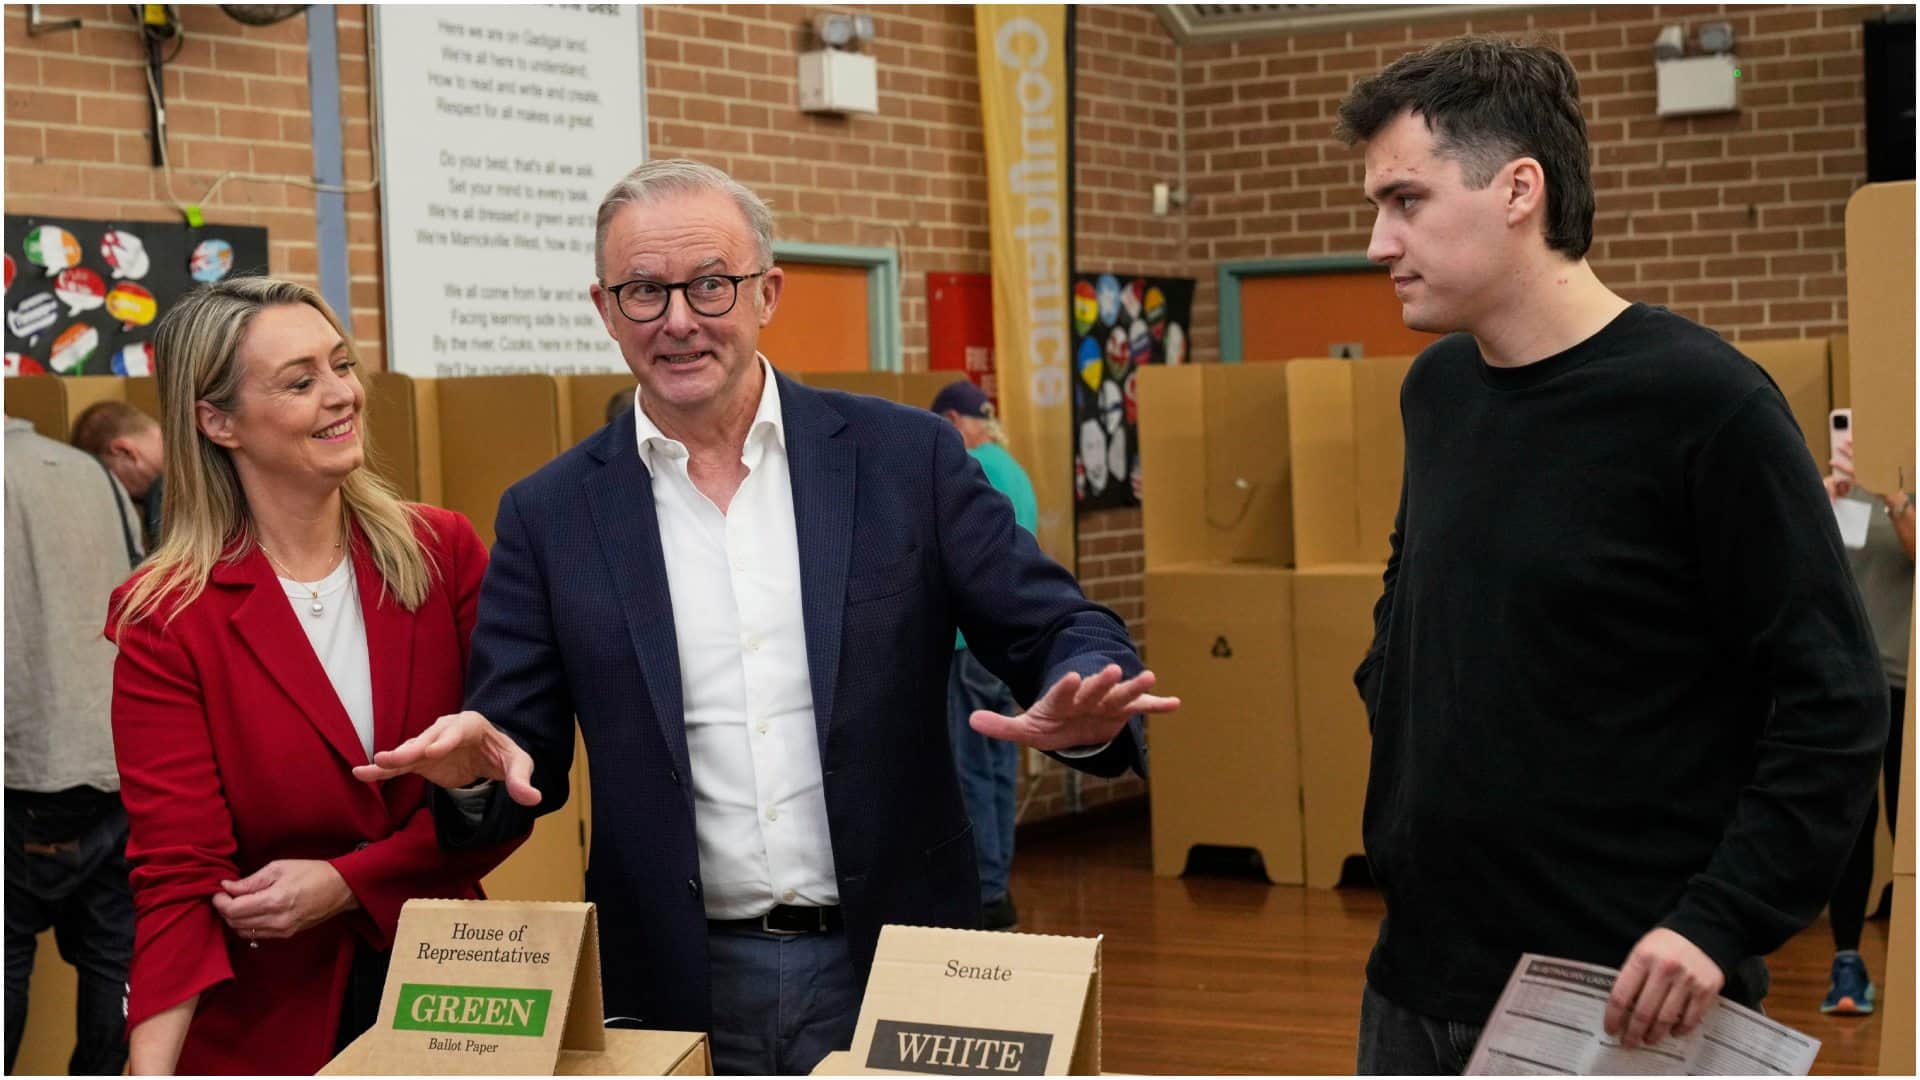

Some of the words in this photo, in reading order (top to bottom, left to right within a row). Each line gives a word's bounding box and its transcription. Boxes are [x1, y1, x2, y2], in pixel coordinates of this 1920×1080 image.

[438, 20, 464, 37] Here
[469, 27, 483, 38] we
[487, 29, 503, 41] are
[506, 31, 519, 42] on
[476, 50, 487, 64] all
[489, 51, 513, 68] here
[516, 56, 527, 70] to
[427, 72, 451, 86] How
[455, 75, 465, 89] to
[470, 78, 493, 92] read
[497, 81, 515, 95] and
[519, 84, 542, 98] write
[547, 87, 565, 100] and
[436, 96, 480, 116] Respect
[484, 103, 497, 118] for
[502, 104, 513, 119] all
[516, 108, 549, 123] makes
[553, 114, 564, 126] us
[440, 149, 456, 167] Do
[459, 157, 482, 173] your
[513, 157, 541, 173] that's
[545, 160, 556, 175] all
[559, 164, 573, 175] we
[448, 178, 466, 194] Set
[470, 183, 493, 198] your
[496, 183, 522, 197] mind
[525, 185, 534, 199] to
[537, 188, 564, 202] every
[428, 203, 458, 219] We're
[463, 206, 474, 220] all
[479, 207, 519, 223] dressed
[522, 210, 531, 222] in
[535, 213, 562, 228] green
[567, 212, 585, 226] and
[416, 229, 448, 245] We're
[545, 236, 565, 251] how
[570, 237, 582, 251] do
[444, 284, 461, 298] We
[466, 284, 477, 299] all
[481, 287, 509, 299] come
[512, 285, 535, 299] from
[538, 284, 551, 300] far
[554, 286, 573, 301] and
[451, 308, 488, 328] Facing
[491, 311, 531, 329] learning
[535, 312, 555, 327] side
[558, 312, 570, 328] by
[433, 333, 447, 354] By
[451, 337, 467, 351] the
[538, 338, 560, 351] here
[564, 339, 573, 351] in
[576, 337, 591, 351] the
[451, 922, 504, 941] House
[508, 925, 528, 942] of
[416, 942, 550, 965] Representatives
[944, 958, 1013, 982] Senate
[411, 994, 535, 1027] GREEN
[428, 1037, 462, 1052] Ballot
[465, 1039, 499, 1056] Paper
[896, 1031, 1025, 1073] WHITE
